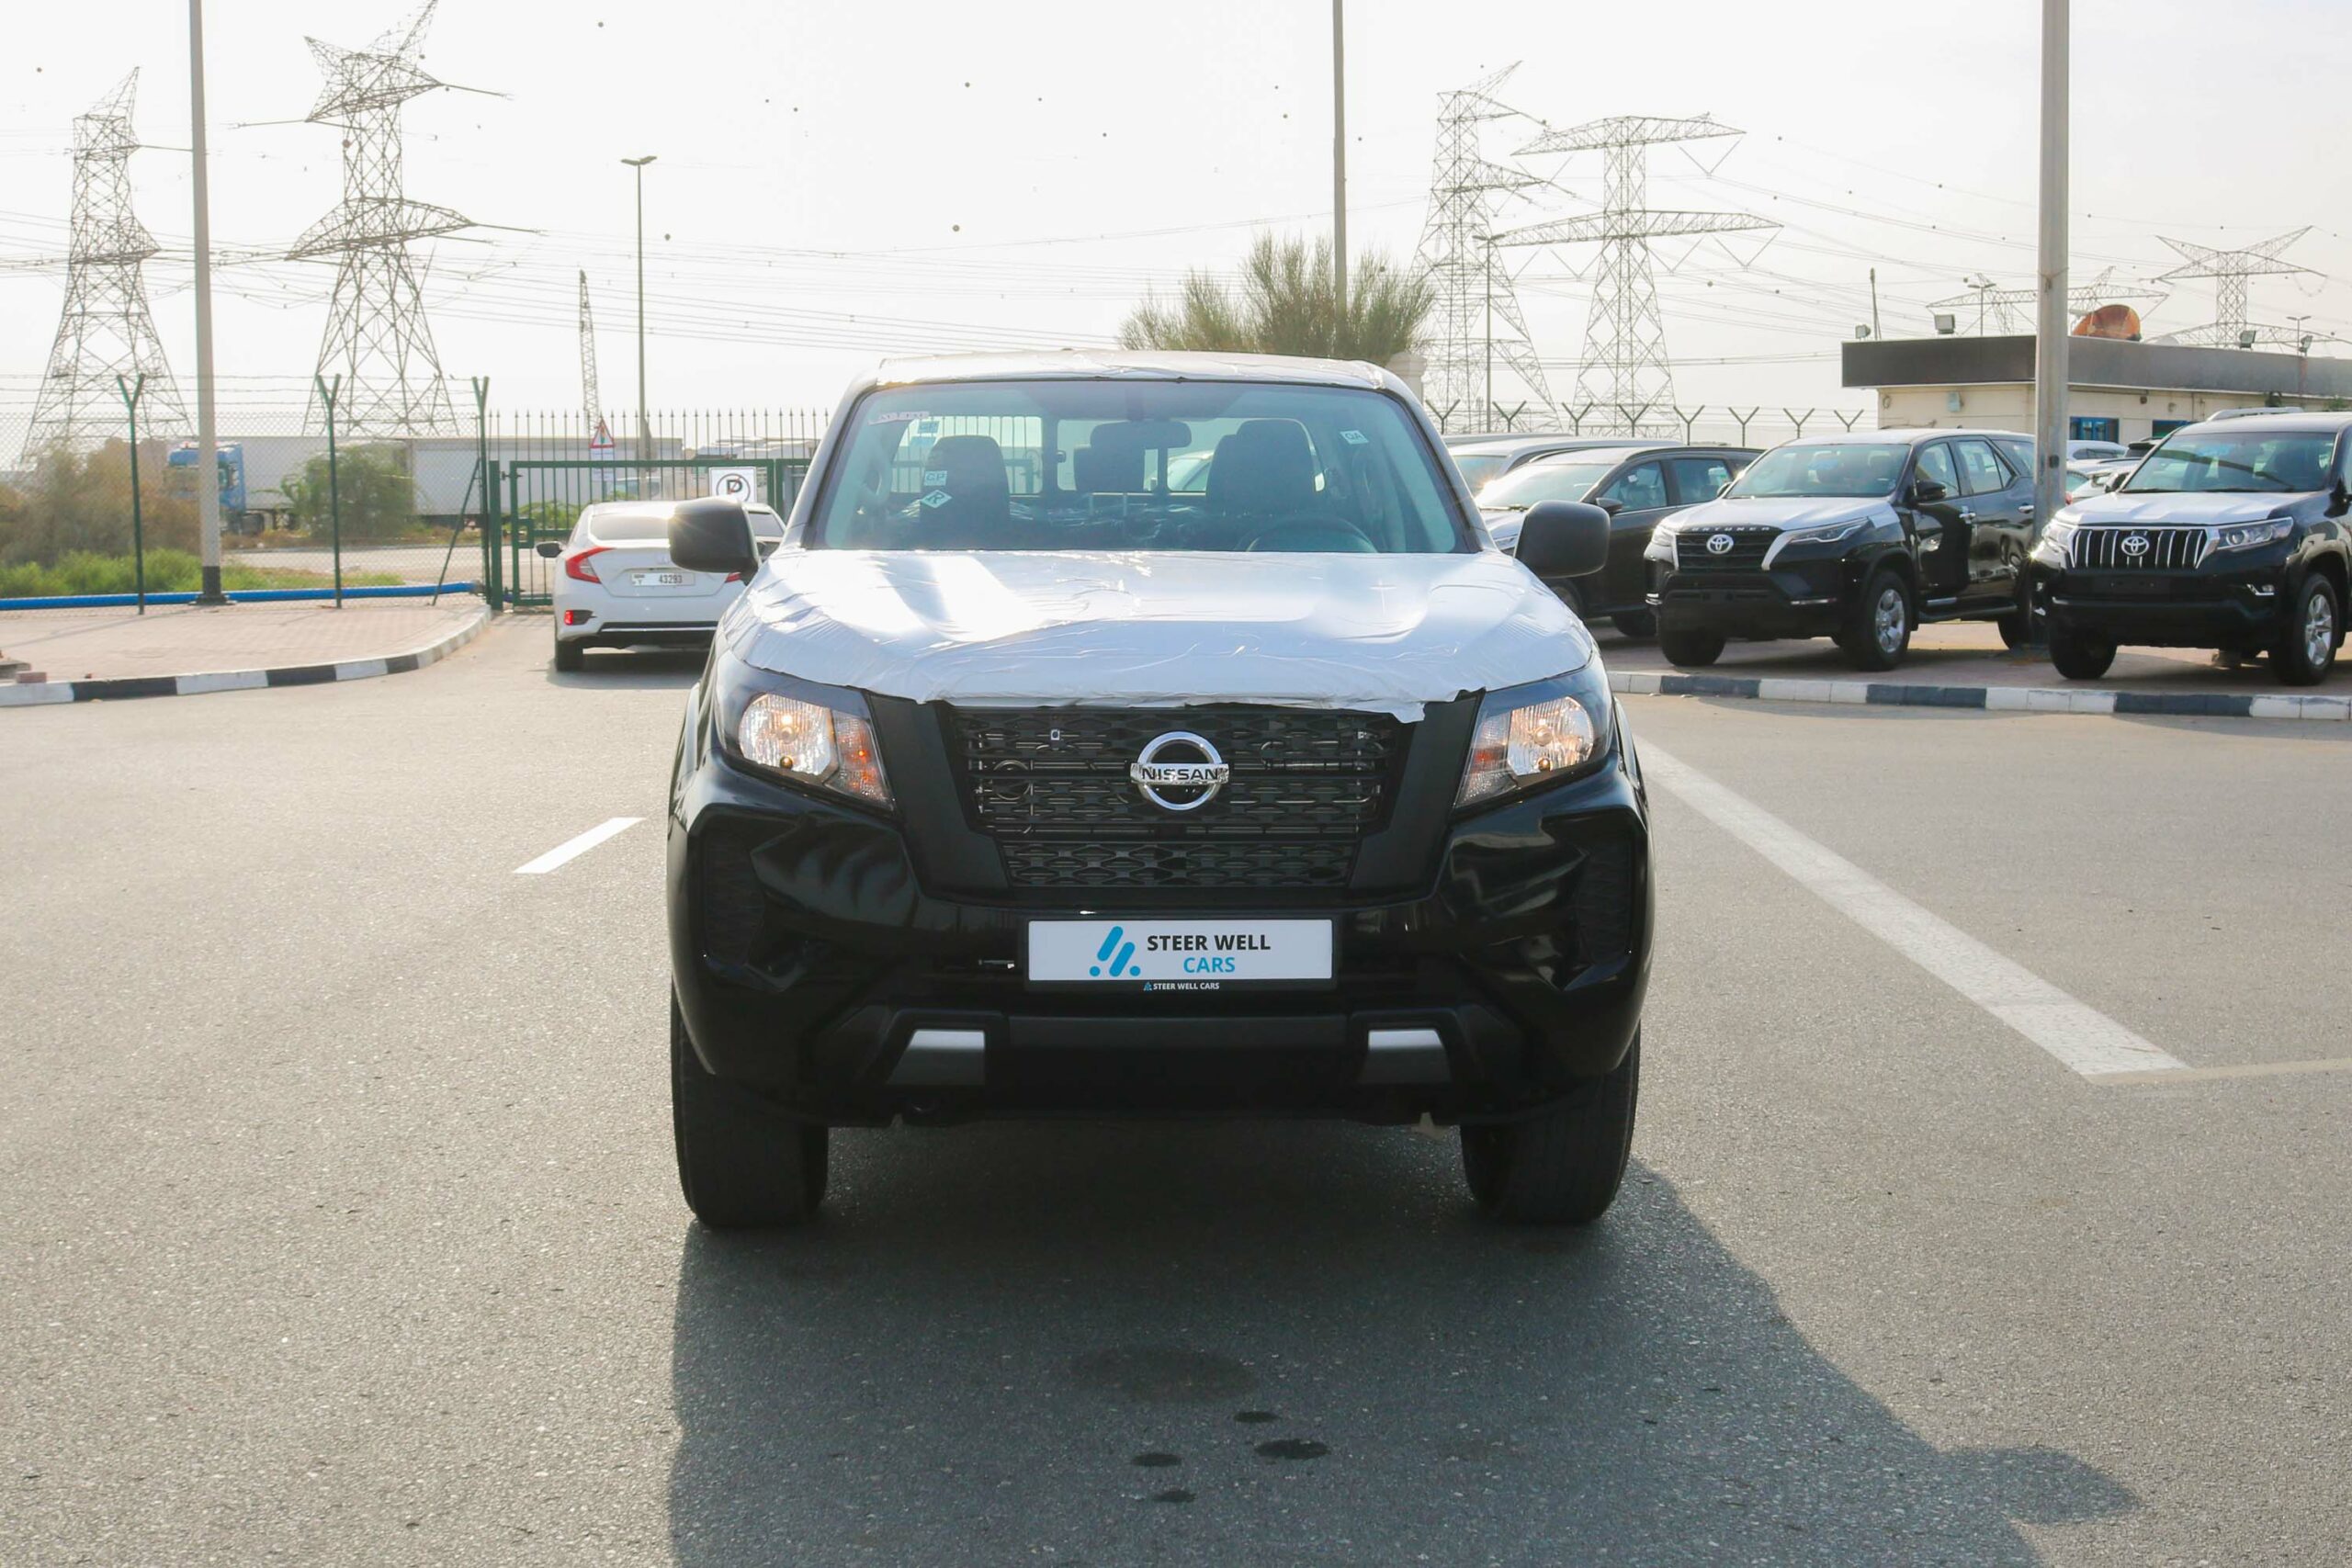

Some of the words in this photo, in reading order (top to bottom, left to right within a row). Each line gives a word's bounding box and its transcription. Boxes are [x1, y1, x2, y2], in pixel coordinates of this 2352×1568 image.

[1142, 768, 1218, 780] NISSAN
[1147, 935, 1207, 952] STEER
[1215, 935, 1271, 951] WELL
[1183, 956, 1236, 974] CARS
[1153, 982, 1176, 990] STEER
[1177, 982, 1199, 990] WELL
[1200, 982, 1220, 990] CARS
